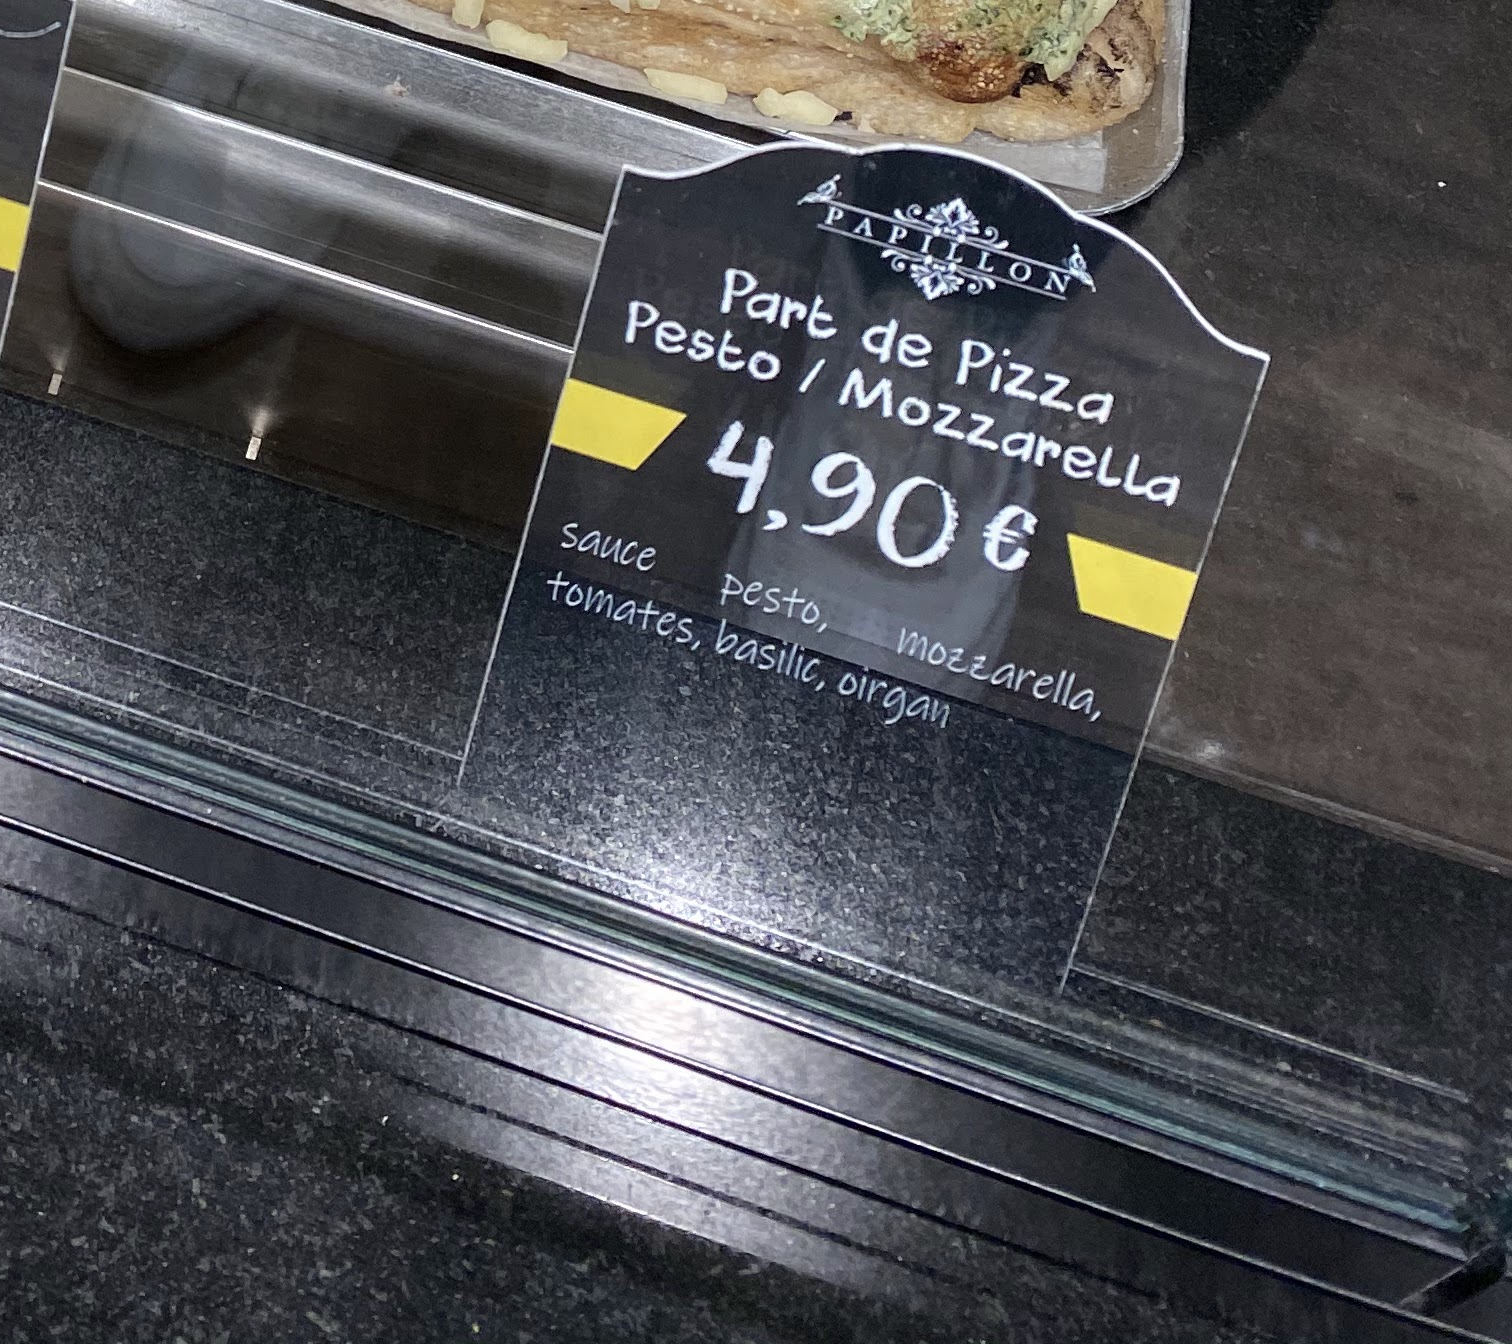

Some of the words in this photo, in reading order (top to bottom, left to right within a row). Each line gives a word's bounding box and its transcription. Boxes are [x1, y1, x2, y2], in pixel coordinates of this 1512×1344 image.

[824, 206, 1075, 292] PAPILLON
[624, 301, 781, 378] Pesto
[798, 357, 826, 394] /
[838, 369, 1181, 506] Mozzarella
[720, 268, 836, 341] Part
[861, 318, 932, 369] de
[957, 339, 1115, 424] Pizza
[546, 570, 701, 650] tomates,
[714, 618, 826, 692] basilic,
[838, 666, 951, 729] oirgan
[560, 522, 657, 572] sauce
[719, 573, 828, 633] pesto,
[897, 628, 1103, 723] mozzarella,
